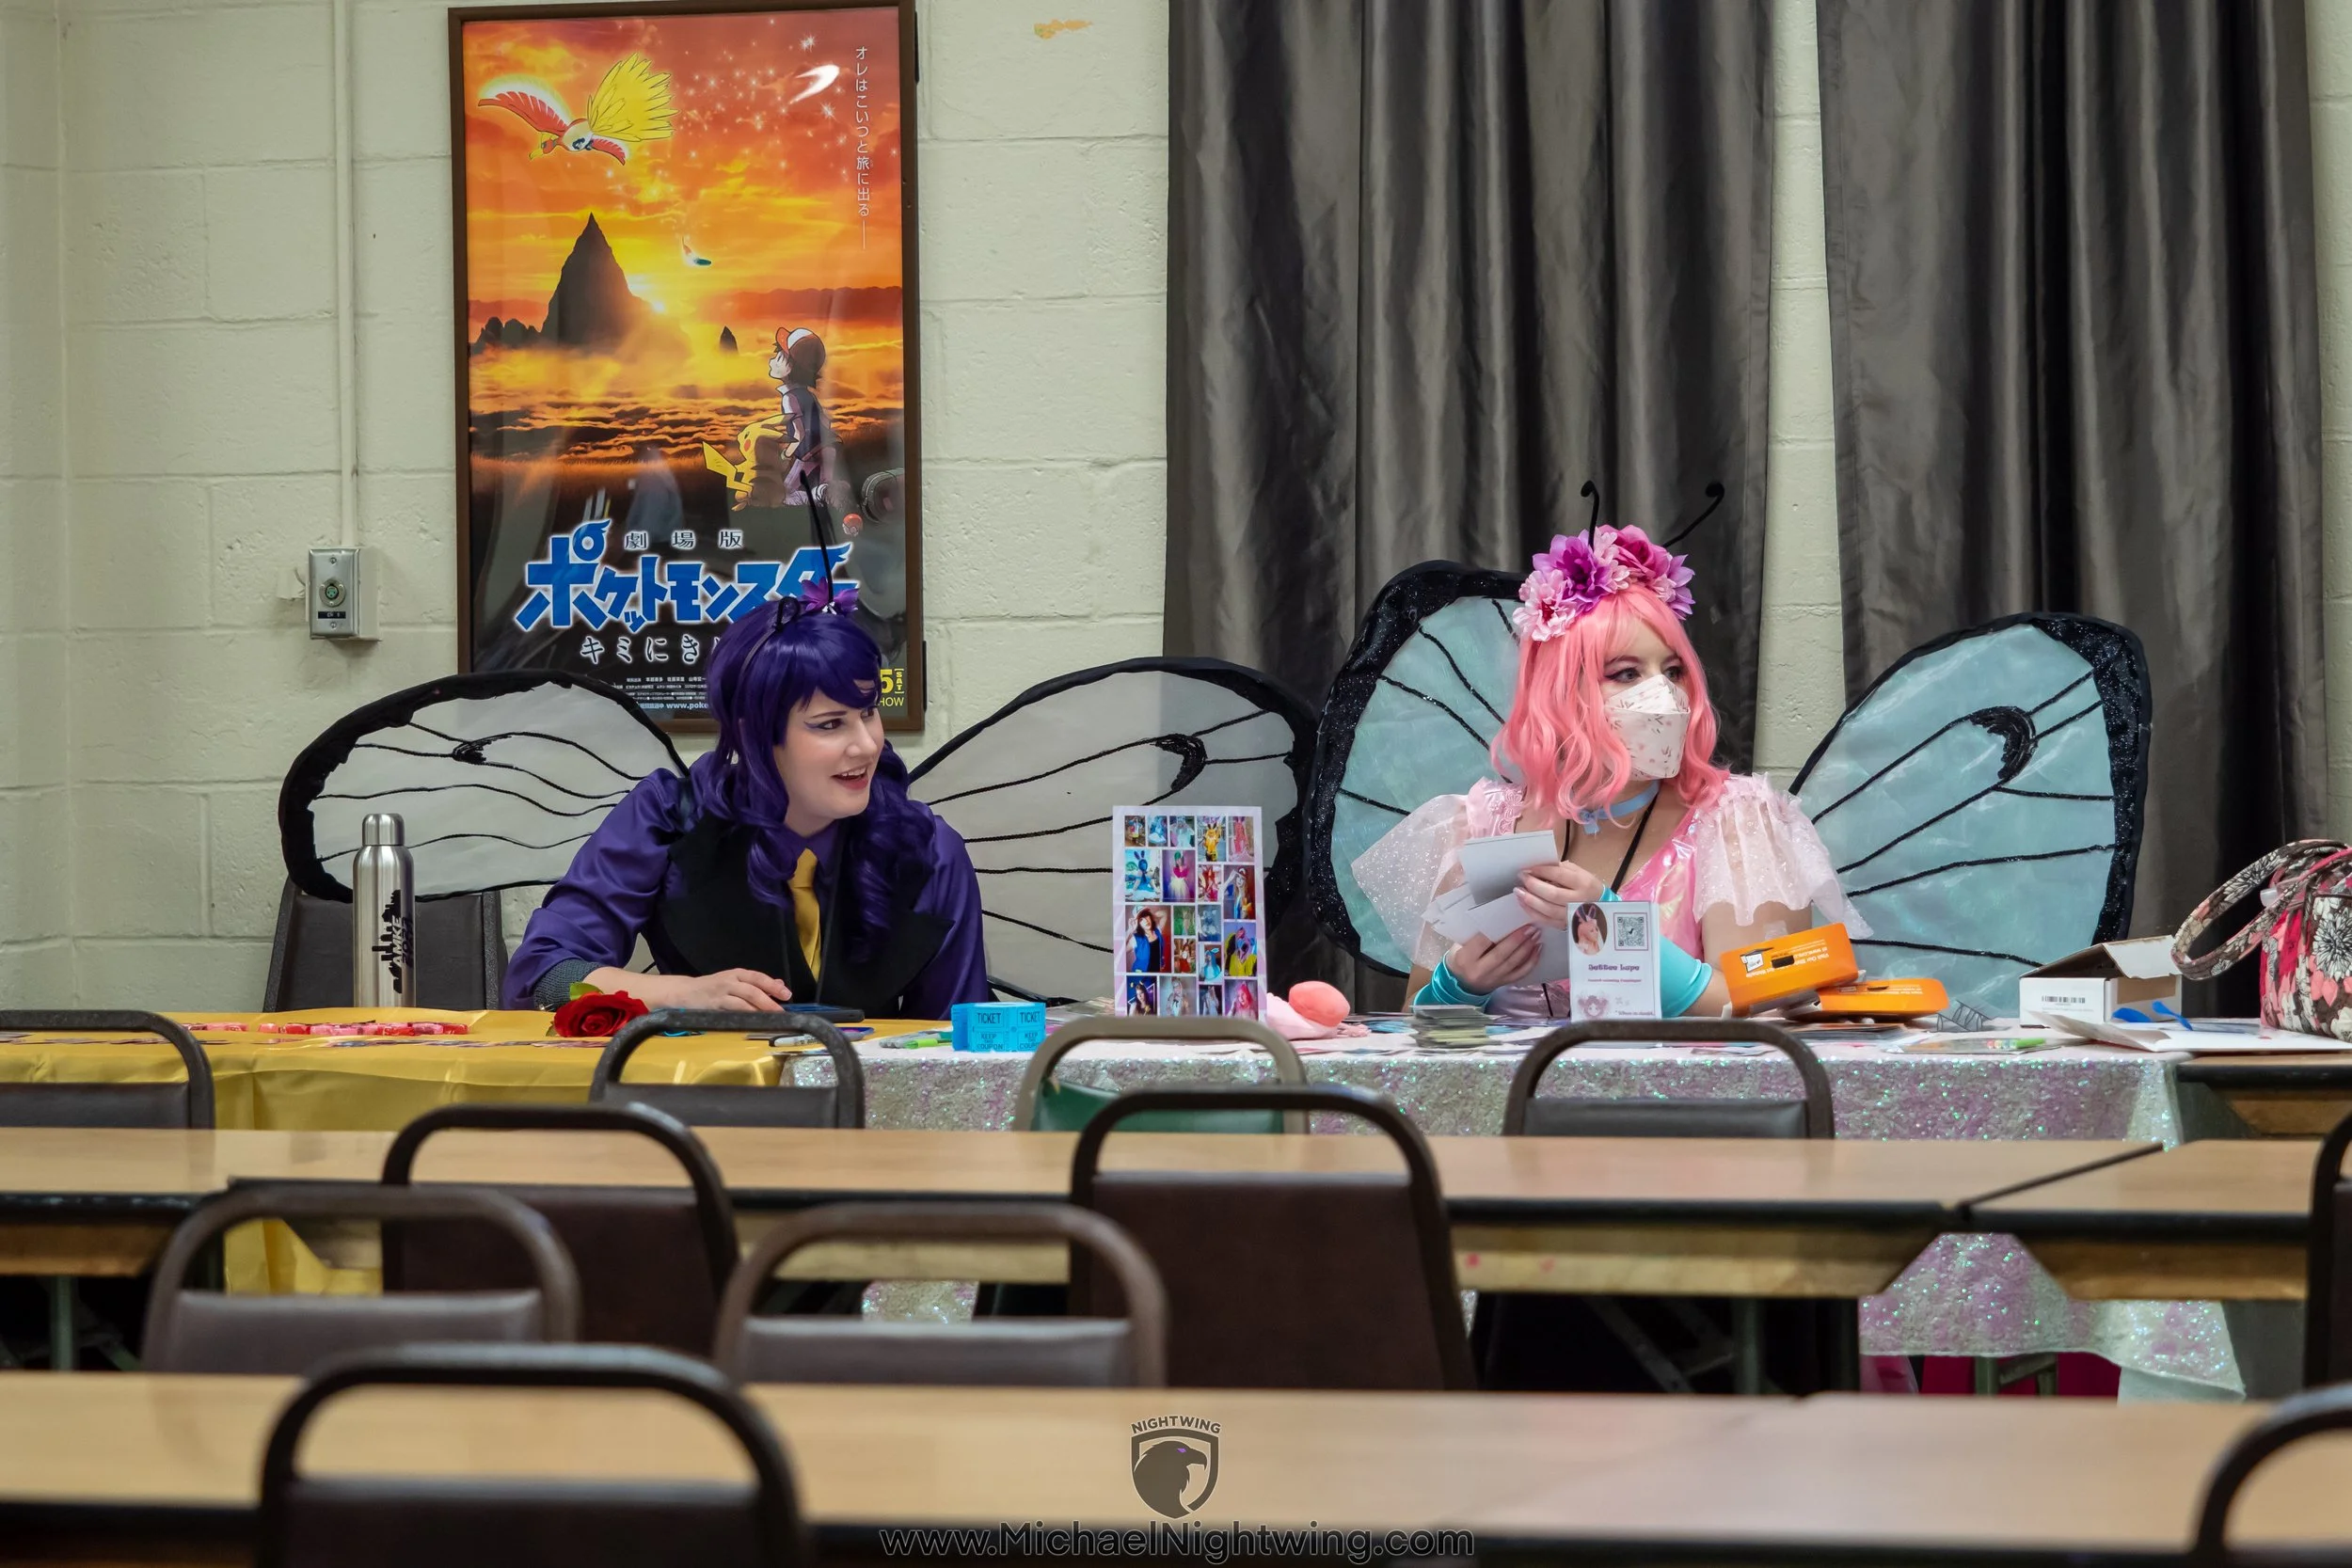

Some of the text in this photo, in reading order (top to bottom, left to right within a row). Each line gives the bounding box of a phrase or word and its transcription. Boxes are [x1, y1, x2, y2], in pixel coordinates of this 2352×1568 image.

[580, 633, 722, 664] キミにき
[880, 669, 894, 693] 5
[880, 697, 904, 706] HOW
[977, 1012, 1002, 1024] TICKET
[1019, 1011, 1041, 1023] TICKET
